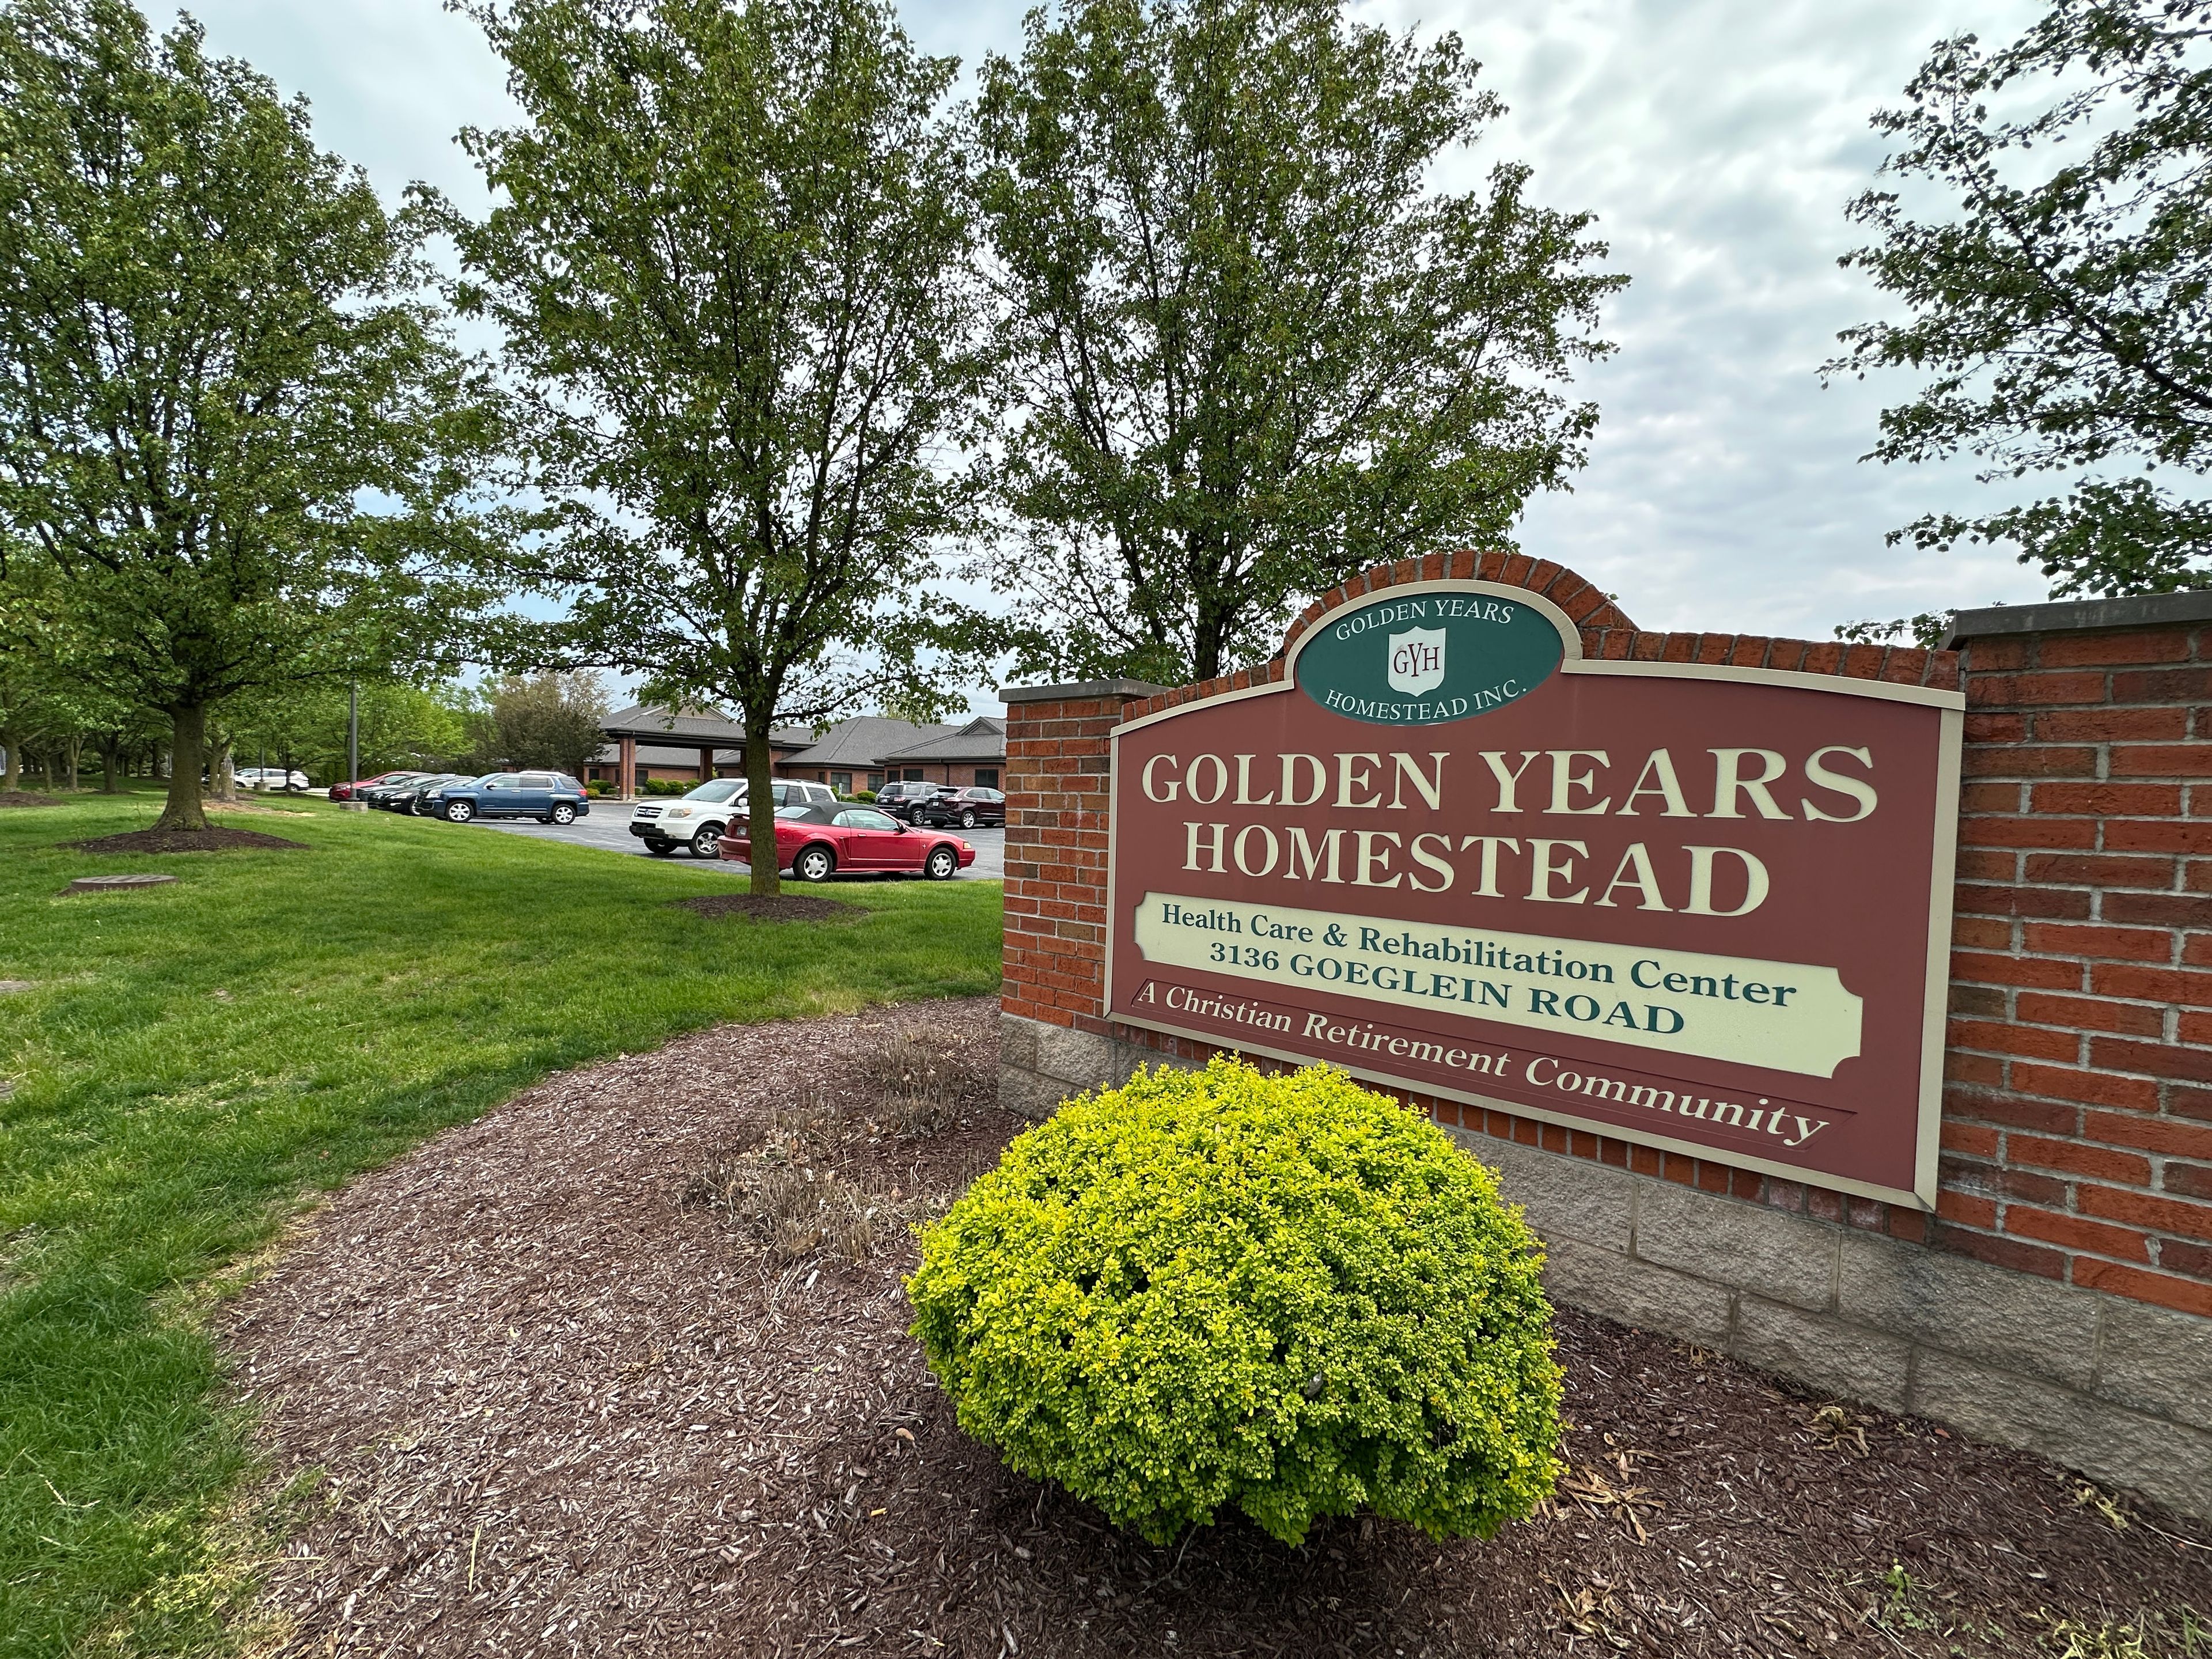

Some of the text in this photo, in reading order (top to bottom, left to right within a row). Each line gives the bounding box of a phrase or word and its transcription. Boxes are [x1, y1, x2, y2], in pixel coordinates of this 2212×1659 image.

[1336, 599, 1514, 640] GOLDEN YEARS
[1393, 642, 1440, 677] GYH
[1324, 679, 1527, 720] HOMESTEAD INC.
[1142, 746, 1878, 823] GOLDEN YEARS
[1181, 821, 1770, 916] HOMESTEAD
[1162, 903, 1797, 1007] Health Care & Rehabilitation Center
[1210, 942, 1684, 1034] 3136 GOEGLEIN ROAD
[1137, 982, 1830, 1147] A Christian Retirement Community
